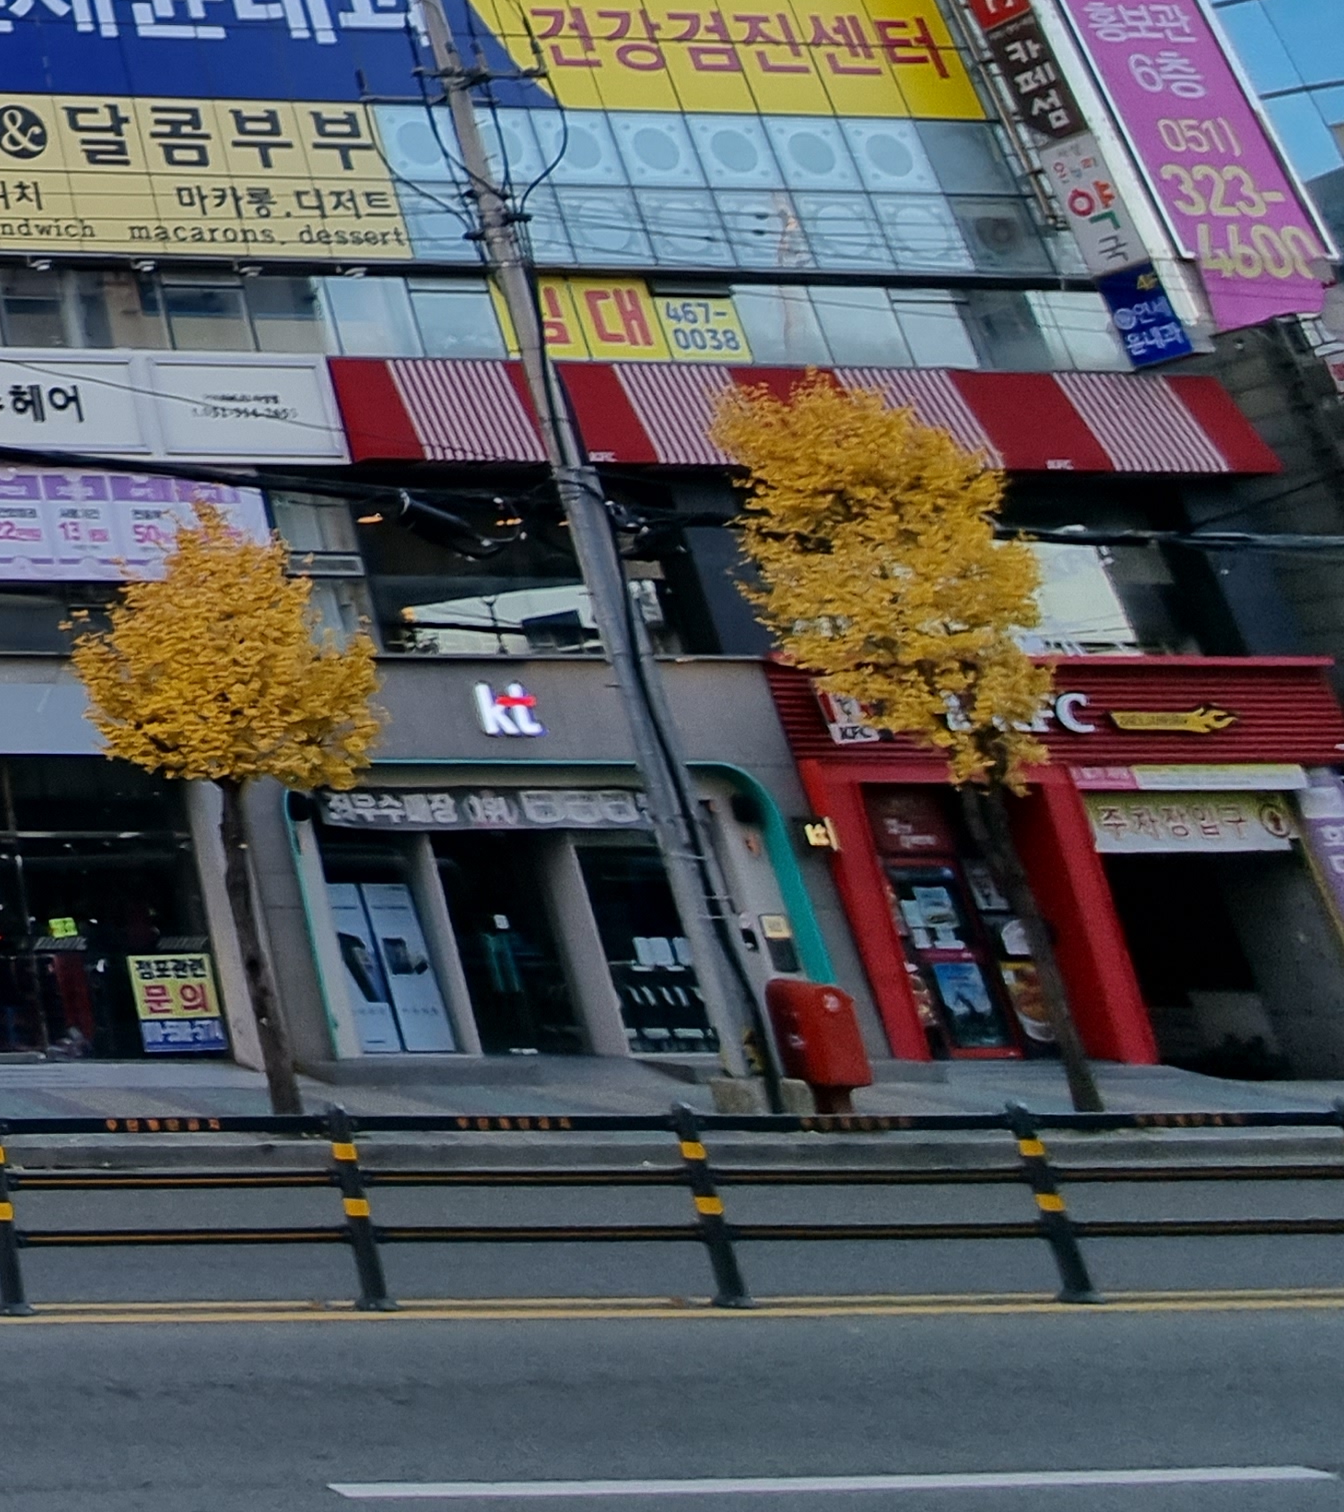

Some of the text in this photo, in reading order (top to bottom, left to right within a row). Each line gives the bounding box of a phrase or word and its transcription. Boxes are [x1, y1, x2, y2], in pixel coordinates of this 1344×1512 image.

[529, 6, 950, 80] 건강검진센터
[1082, 0, 1196, 44] 홍보관
[1127, 50, 1207, 99] 6층
[673, 327, 740, 352] 0038
[474, 681, 547, 738] kt
[142, 984, 210, 1013] 문의
